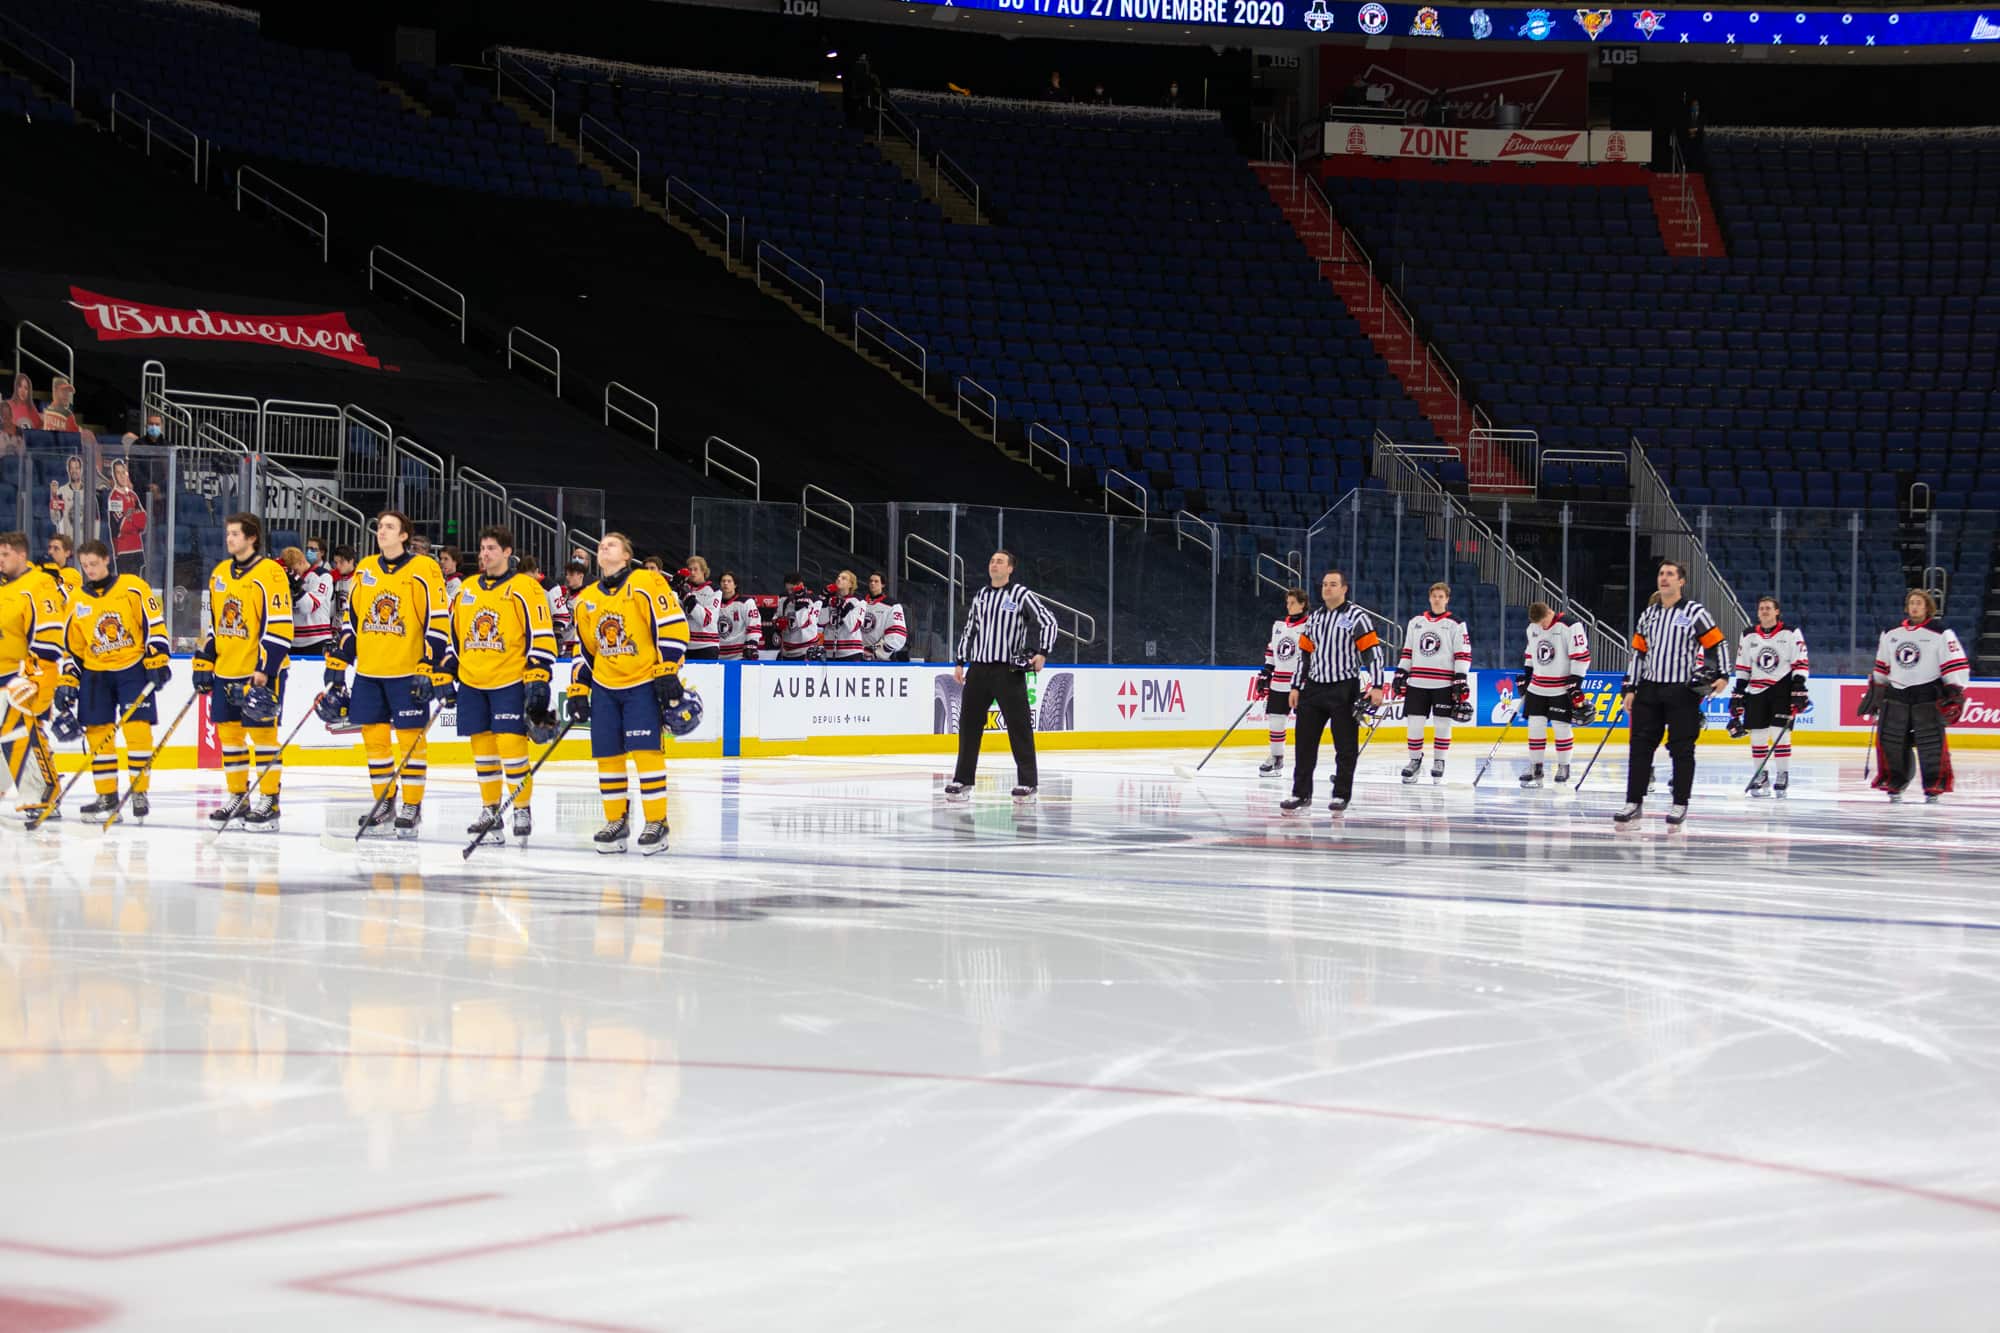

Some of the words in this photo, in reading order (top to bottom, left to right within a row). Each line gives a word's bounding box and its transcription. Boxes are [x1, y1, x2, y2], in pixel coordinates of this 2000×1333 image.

[783, 1, 819, 17] 104
[1120, 0, 1228, 24] NOVEMBRE
[1233, 0, 1285, 26] 2020
[1602, 49, 1638, 65] 105
[1400, 128, 1469, 157] ZONE
[1505, 136, 1571, 153] Budweiser
[68, 300, 365, 352] Budweiser
[1573, 634, 1585, 647] 13
[773, 677, 909, 698] AUBAINERIE
[1141, 679, 1186, 713] PMA
[399, 709, 424, 717] CCM
[812, 715, 842, 724] DEPUIS
[853, 715, 871, 723] 1944
